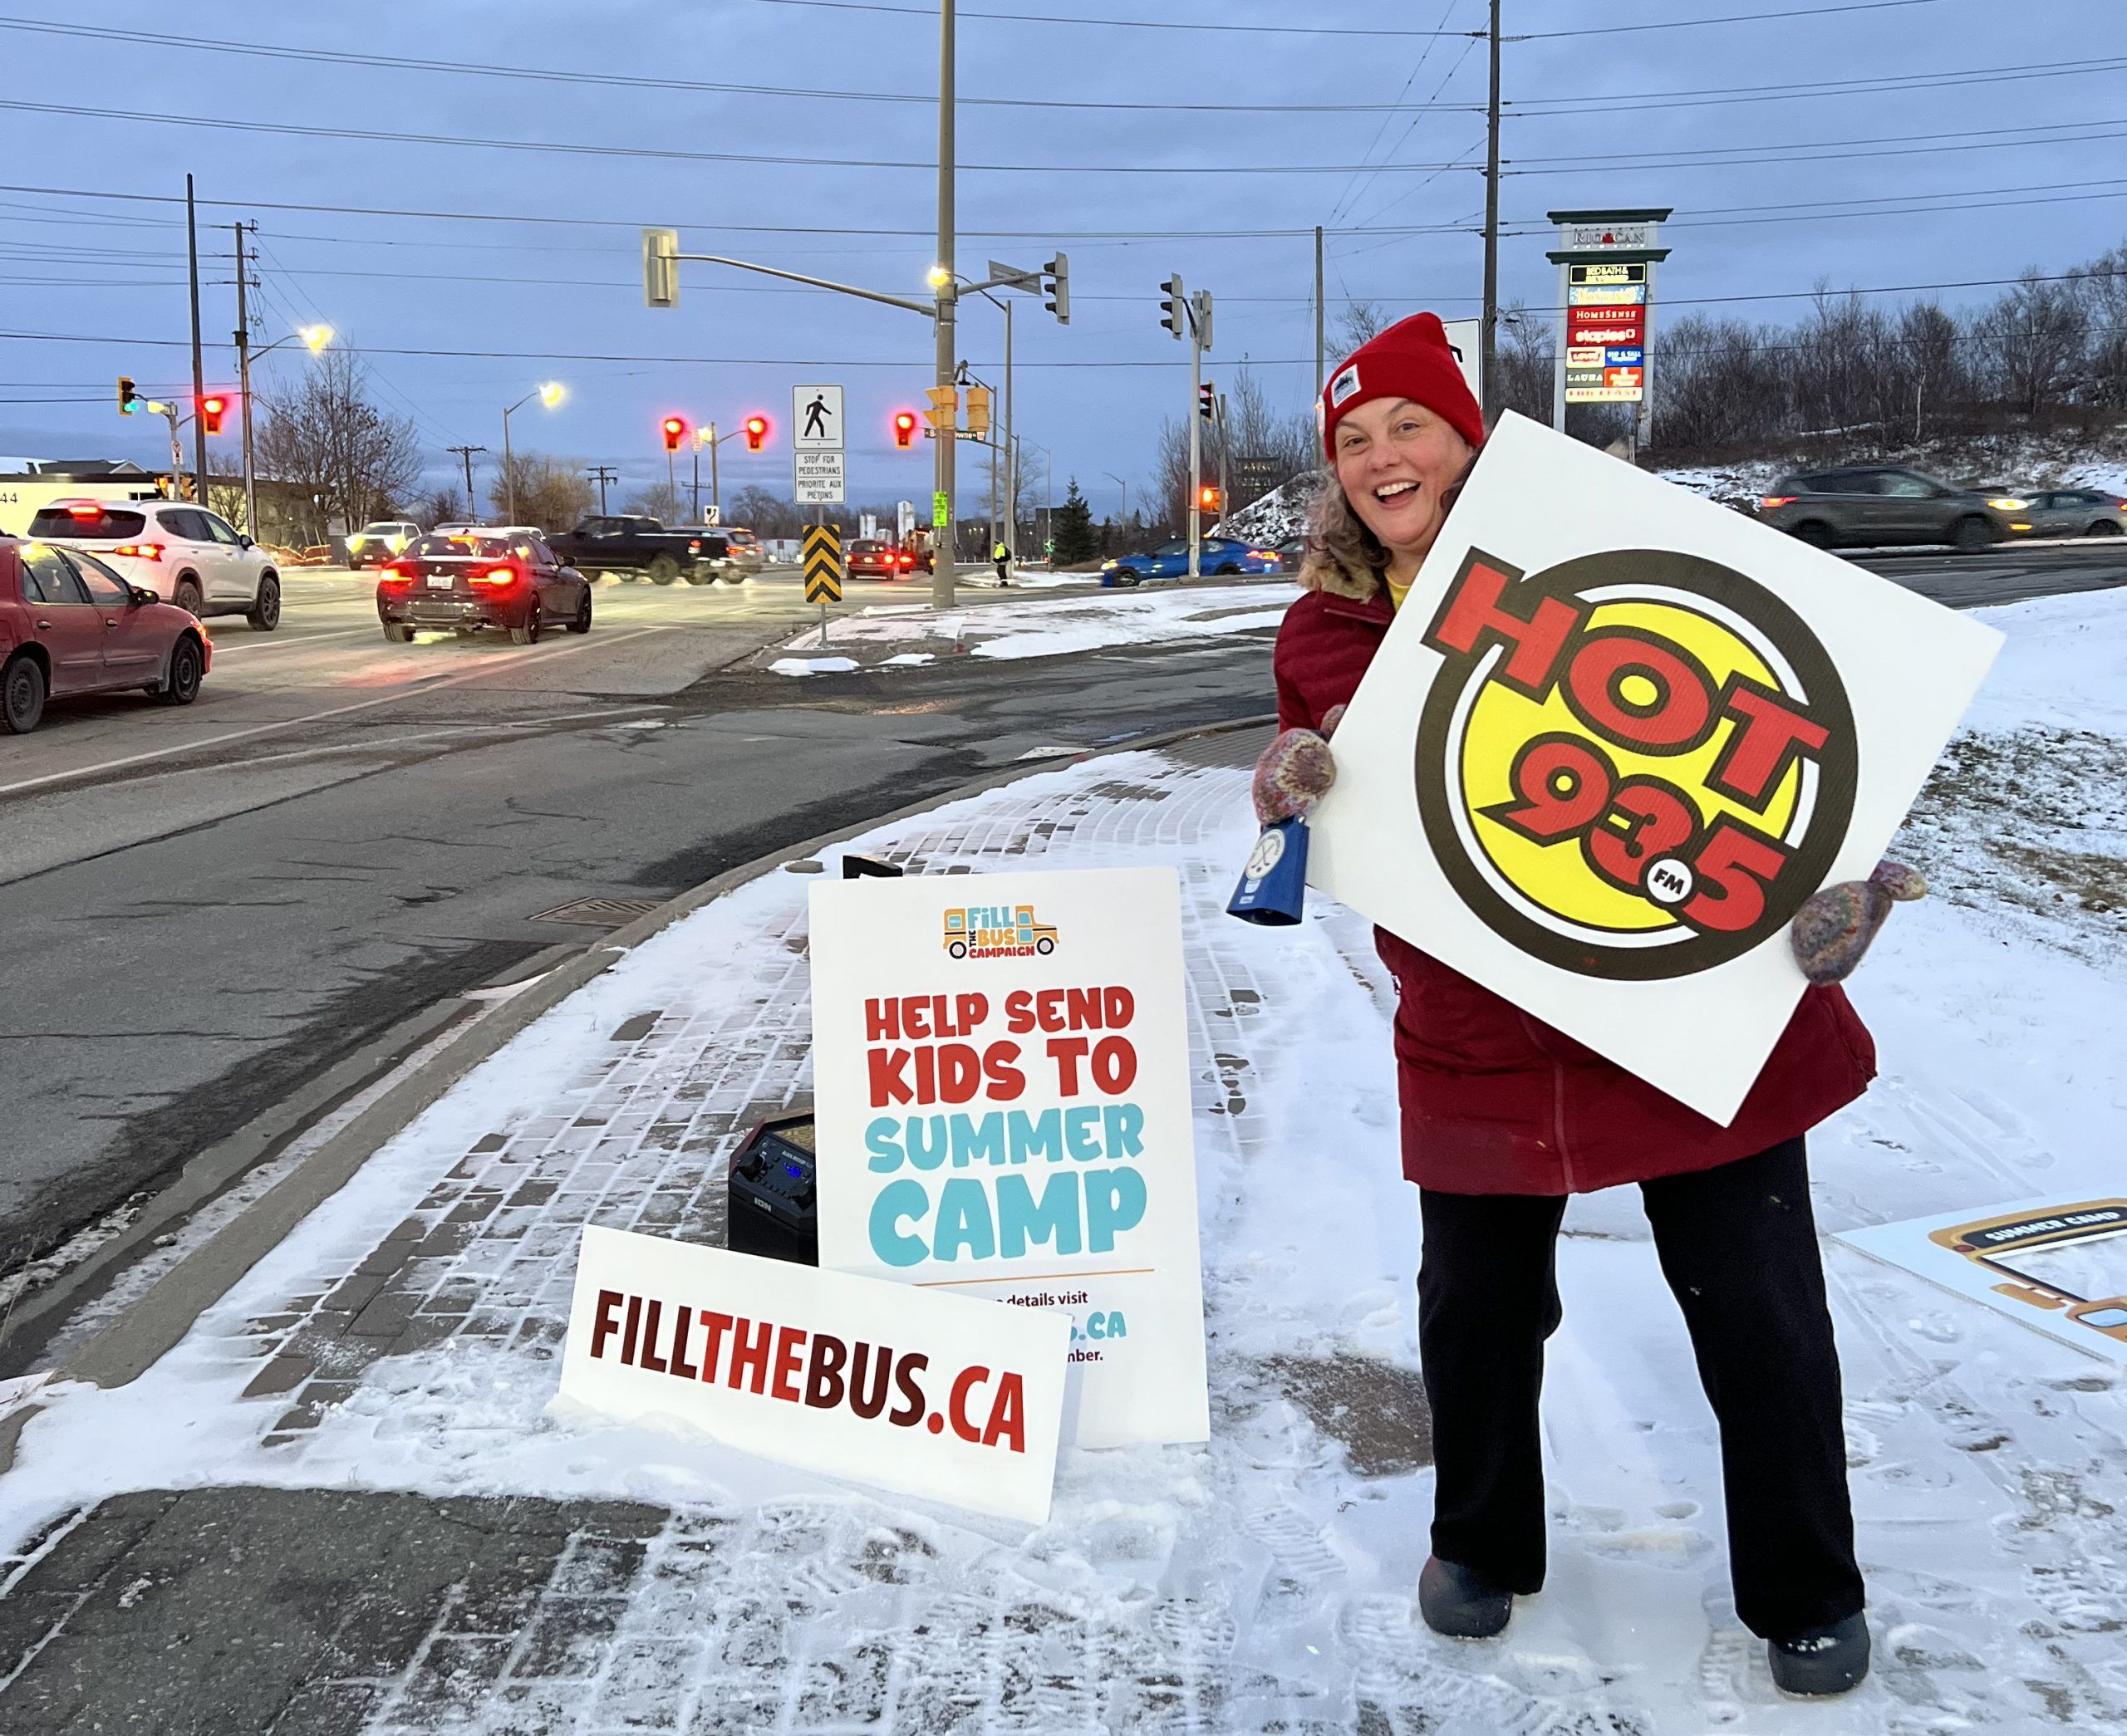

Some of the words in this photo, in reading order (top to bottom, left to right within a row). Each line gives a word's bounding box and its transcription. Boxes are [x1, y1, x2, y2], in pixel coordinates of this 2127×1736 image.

[1567, 374, 1604, 382] LAURA
[798, 466, 841, 474] PEDESTRIANS
[804, 455, 820, 464] STOP
[823, 455, 835, 464] FOR
[829, 480, 842, 488] AUX
[1436, 562, 1830, 799] HOT
[1653, 868, 1685, 896] FM
[977, 928, 1016, 947] BUS
[968, 945, 1035, 959] CAMPAIGN
[864, 992, 990, 1042] HELP
[1005, 986, 1135, 1034] SEND
[867, 1040, 1027, 1108] KIDS
[1046, 1035, 1137, 1097] TO
[864, 1103, 1145, 1174] SUMMER
[754, 1197, 772, 1213] ION
[868, 1166, 1148, 1268] CAMP
[1985, 1219, 2067, 1242] SUMMER
[1007, 1292, 1055, 1307] details
[1058, 1291, 1088, 1305] visit
[590, 1289, 1026, 1454] FILLTHEBUS.CA
